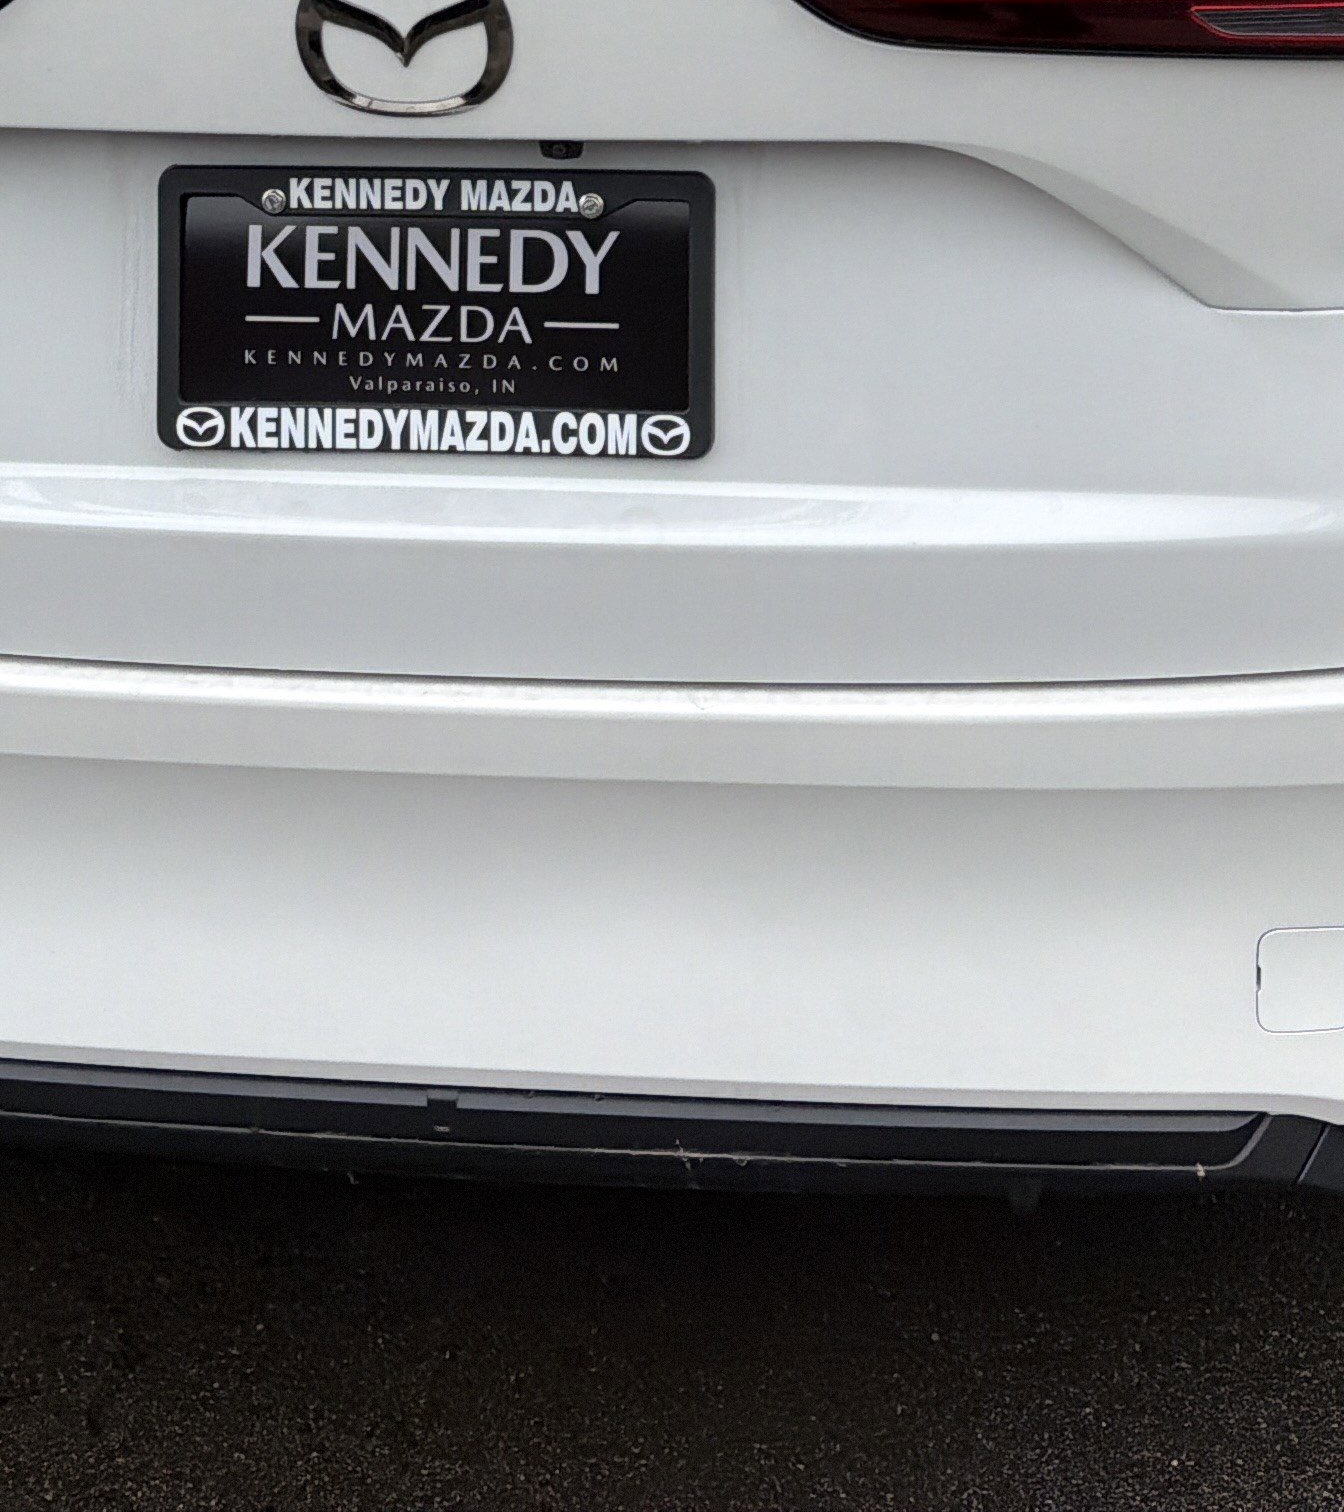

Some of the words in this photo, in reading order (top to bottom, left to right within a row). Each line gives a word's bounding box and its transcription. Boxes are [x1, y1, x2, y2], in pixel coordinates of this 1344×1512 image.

[289, 177, 451, 212] KENNEDY
[461, 179, 579, 214] MAZDA
[246, 224, 620, 295] KENNEDY
[331, 303, 533, 344] MAZDA
[244, 349, 619, 373] KENNEDYMAZDA.COM
[349, 375, 479, 396] Valparaiso,
[492, 379, 516, 394] IN
[230, 407, 638, 456] KENNEDYMAZDA.COM
